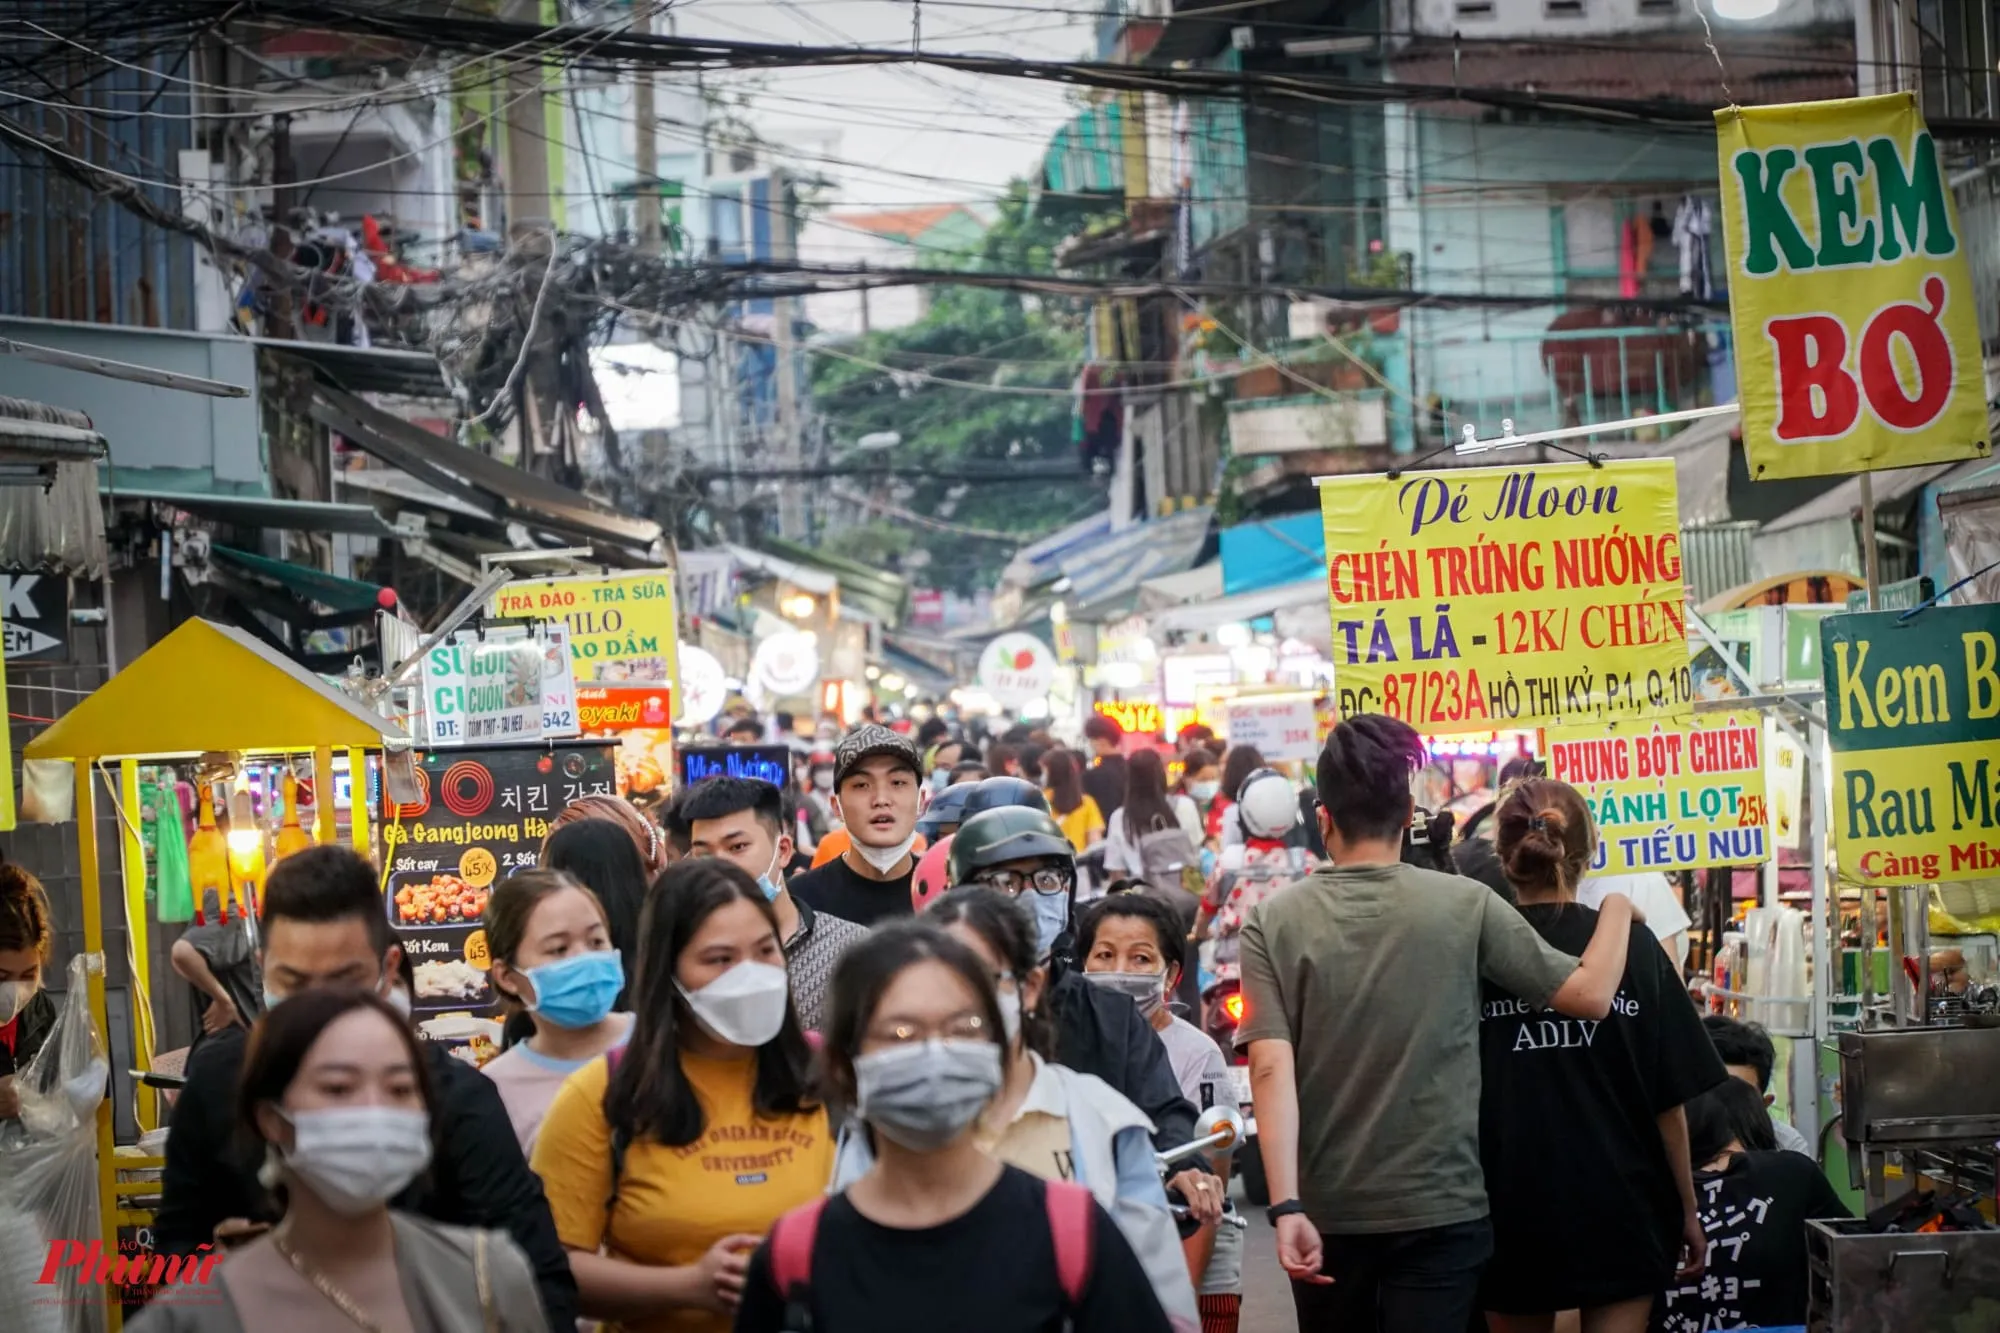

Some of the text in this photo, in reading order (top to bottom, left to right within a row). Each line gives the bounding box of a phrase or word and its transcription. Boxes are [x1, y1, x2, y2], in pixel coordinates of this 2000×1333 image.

[1735, 132, 1956, 274] KEM
[1768, 277, 1953, 440] BƠ
[1483, 471, 1624, 523] Moon
[1330, 524, 1682, 604] CHÉN TRỨNG NƯỚNG
[1337, 608, 1399, 665] TÁ
[1408, 604, 1461, 660] LÃ
[1579, 589, 1687, 650] CHÉN
[1488, 670, 1520, 719] HỒ
[1525, 676, 1561, 725] THỊ
[1833, 640, 1950, 730] Kem
[436, 720, 460, 737] ĐT:
[578, 703, 641, 727] oyaki
[1552, 717, 1758, 793] PHỤNG BỘT CHIÊN
[1680, 786, 1742, 822] LỌT
[1844, 759, 2000, 840] Rau M
[413, 821, 518, 845] Gangjeong
[524, 818, 552, 838] Hà
[1619, 824, 1696, 867] TIẾU
[1708, 827, 1763, 860] NUI
[1860, 850, 1940, 880] Càng
[422, 939, 449, 953] Kem
[1512, 1019, 1600, 1051] ADLV
